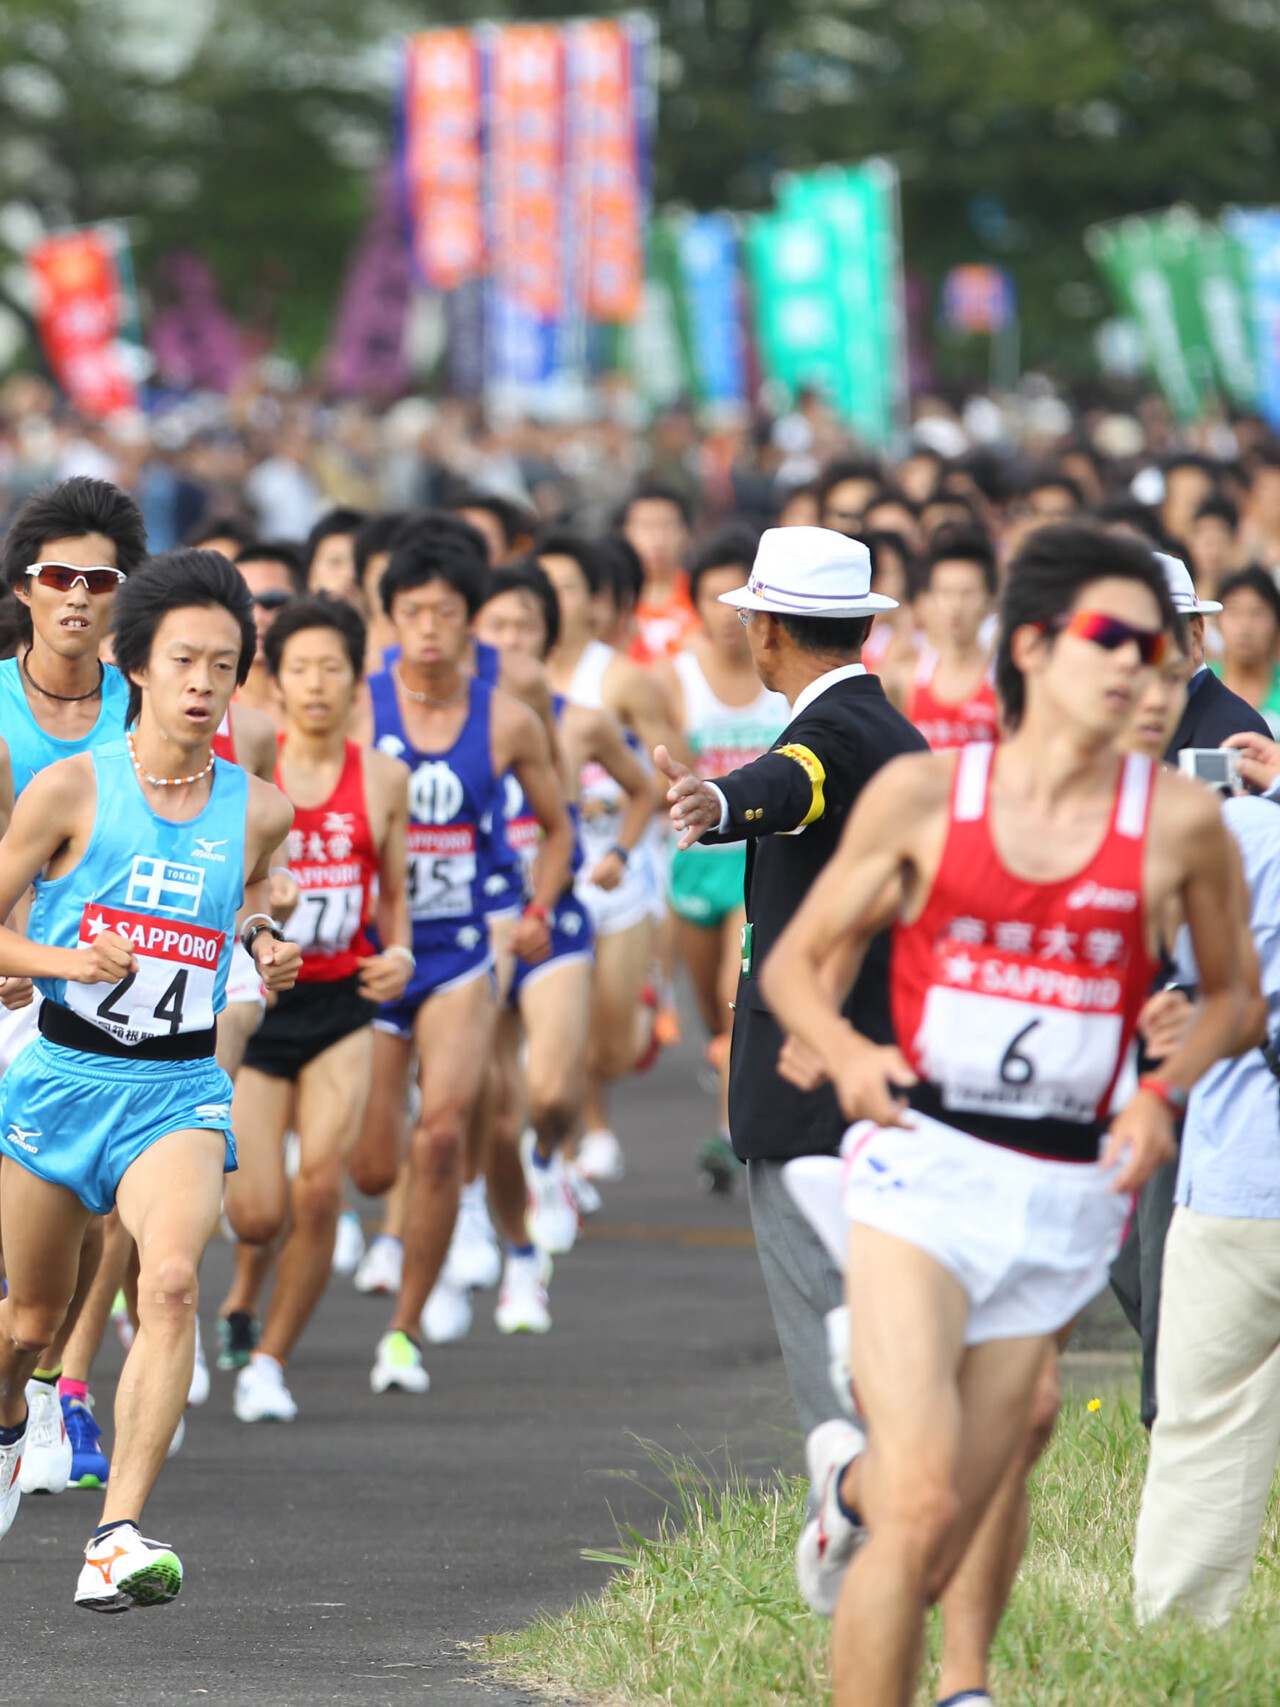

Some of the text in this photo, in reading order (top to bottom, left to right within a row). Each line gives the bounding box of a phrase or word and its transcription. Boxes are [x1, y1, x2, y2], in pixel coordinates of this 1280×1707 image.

[407, 830, 472, 850] PPORO
[167, 869, 196, 882] TOKAI
[290, 864, 361, 887] APPORO
[116, 921, 218, 962] SAPPORO
[96, 968, 190, 1034] 24
[979, 958, 1121, 1010] SAPPORO
[1000, 1018, 1040, 1086] 6
